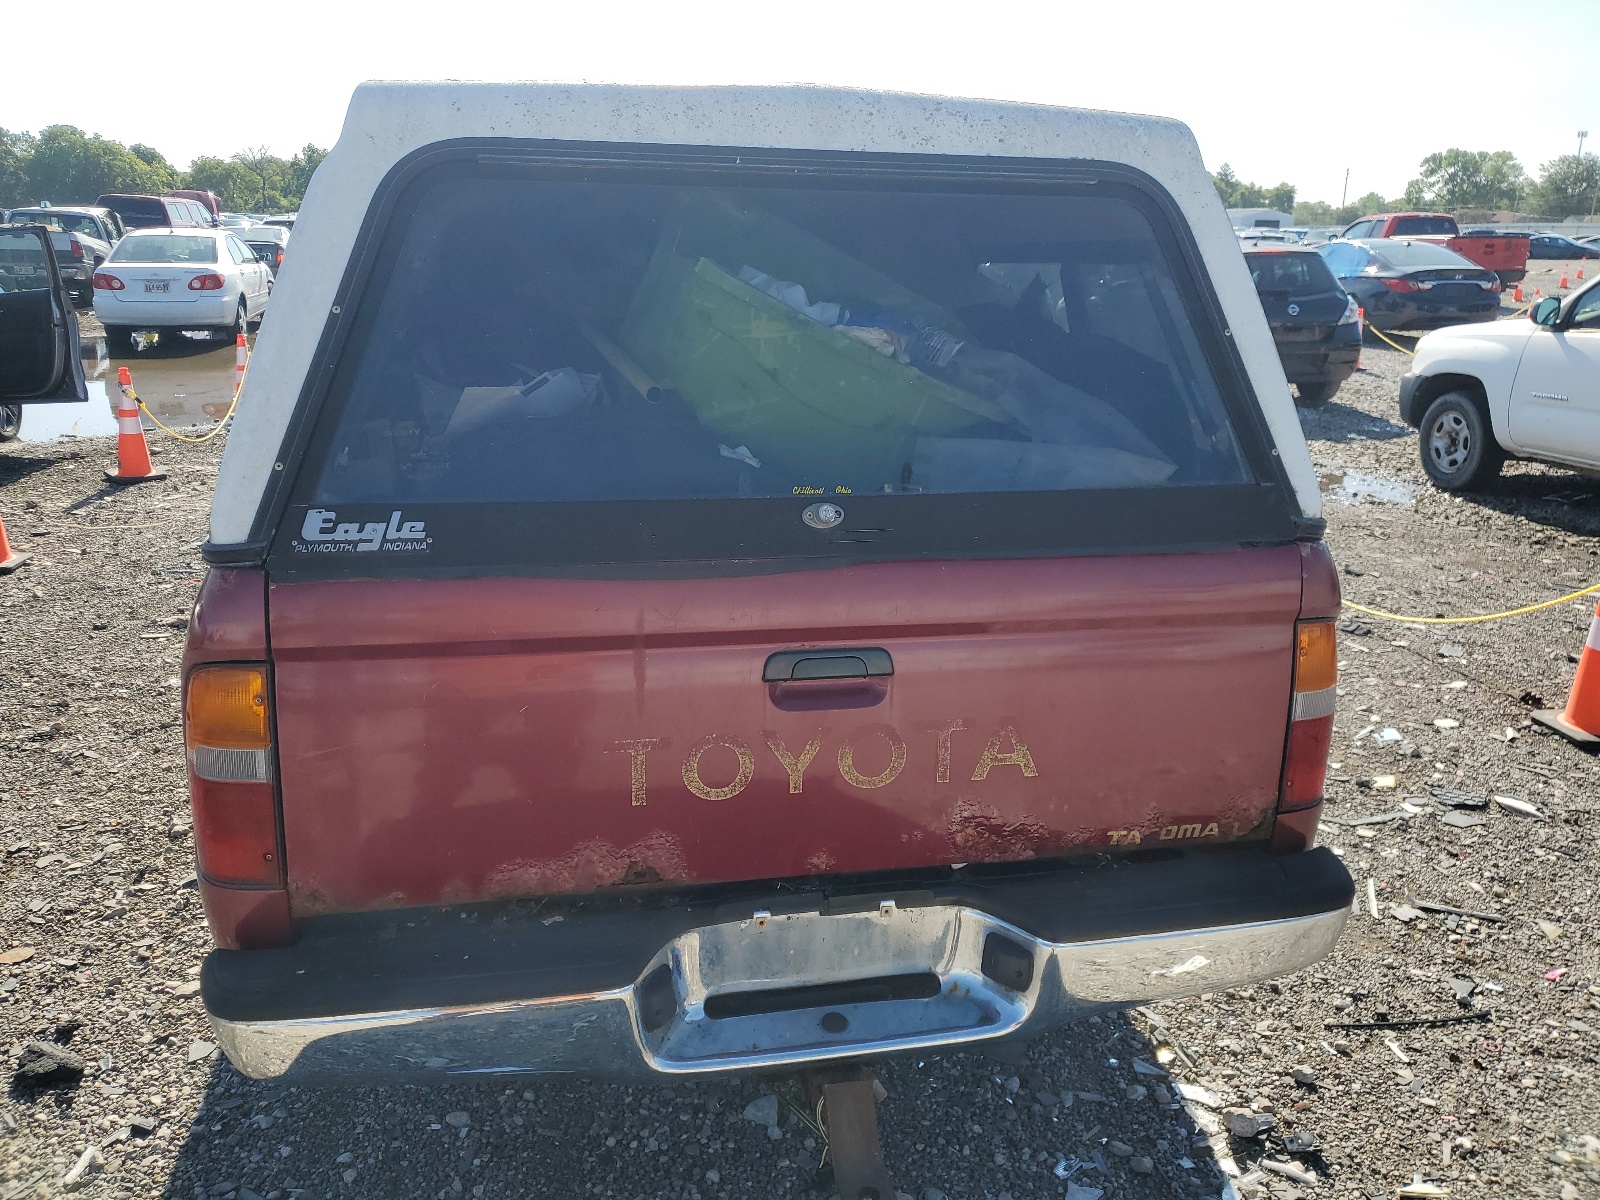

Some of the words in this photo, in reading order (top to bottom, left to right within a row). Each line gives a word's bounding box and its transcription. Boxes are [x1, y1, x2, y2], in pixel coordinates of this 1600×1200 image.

[835, 485, 852, 494] Ohio
[301, 508, 427, 552] Eagle
[382, 541, 427, 551] INDIANA
[604, 715, 1039, 806] TOYOTA
